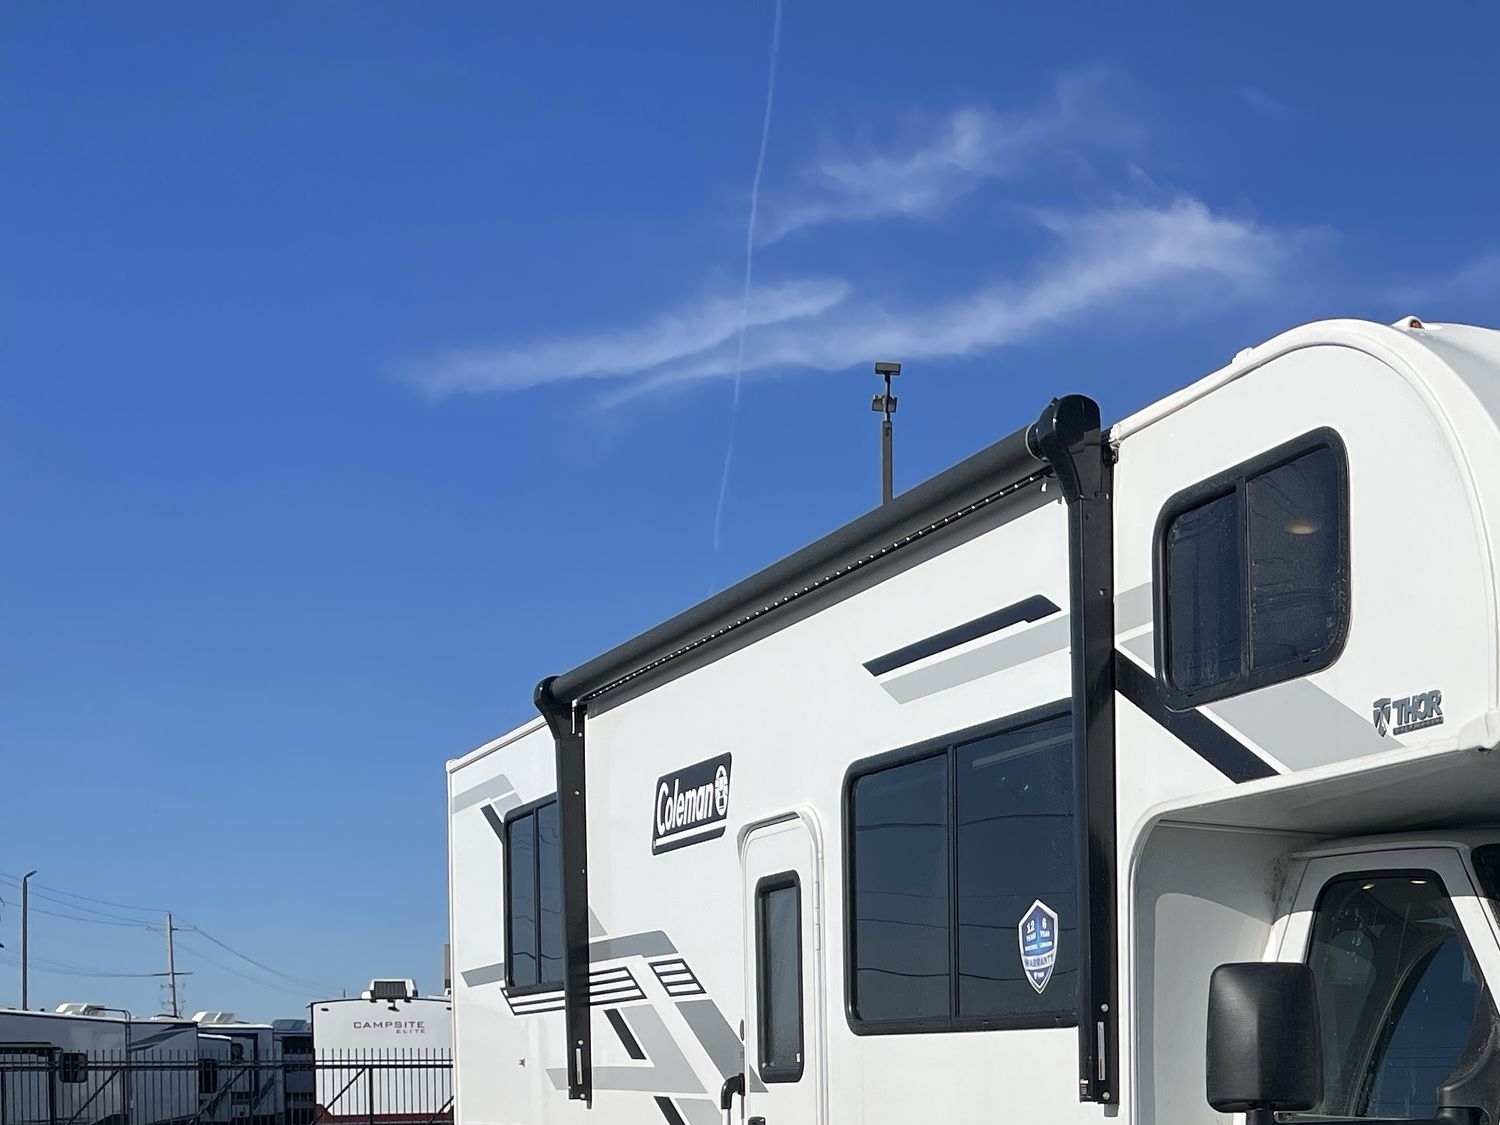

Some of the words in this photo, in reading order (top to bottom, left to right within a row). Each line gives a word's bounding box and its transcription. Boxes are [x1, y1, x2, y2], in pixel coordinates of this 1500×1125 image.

[1392, 689, 1443, 726] THOR
[656, 778, 714, 836] Coleman
[1026, 919, 1036, 934] 12
[1041, 917, 1047, 929] 6
[353, 1021, 425, 1029] CAMPSITE
